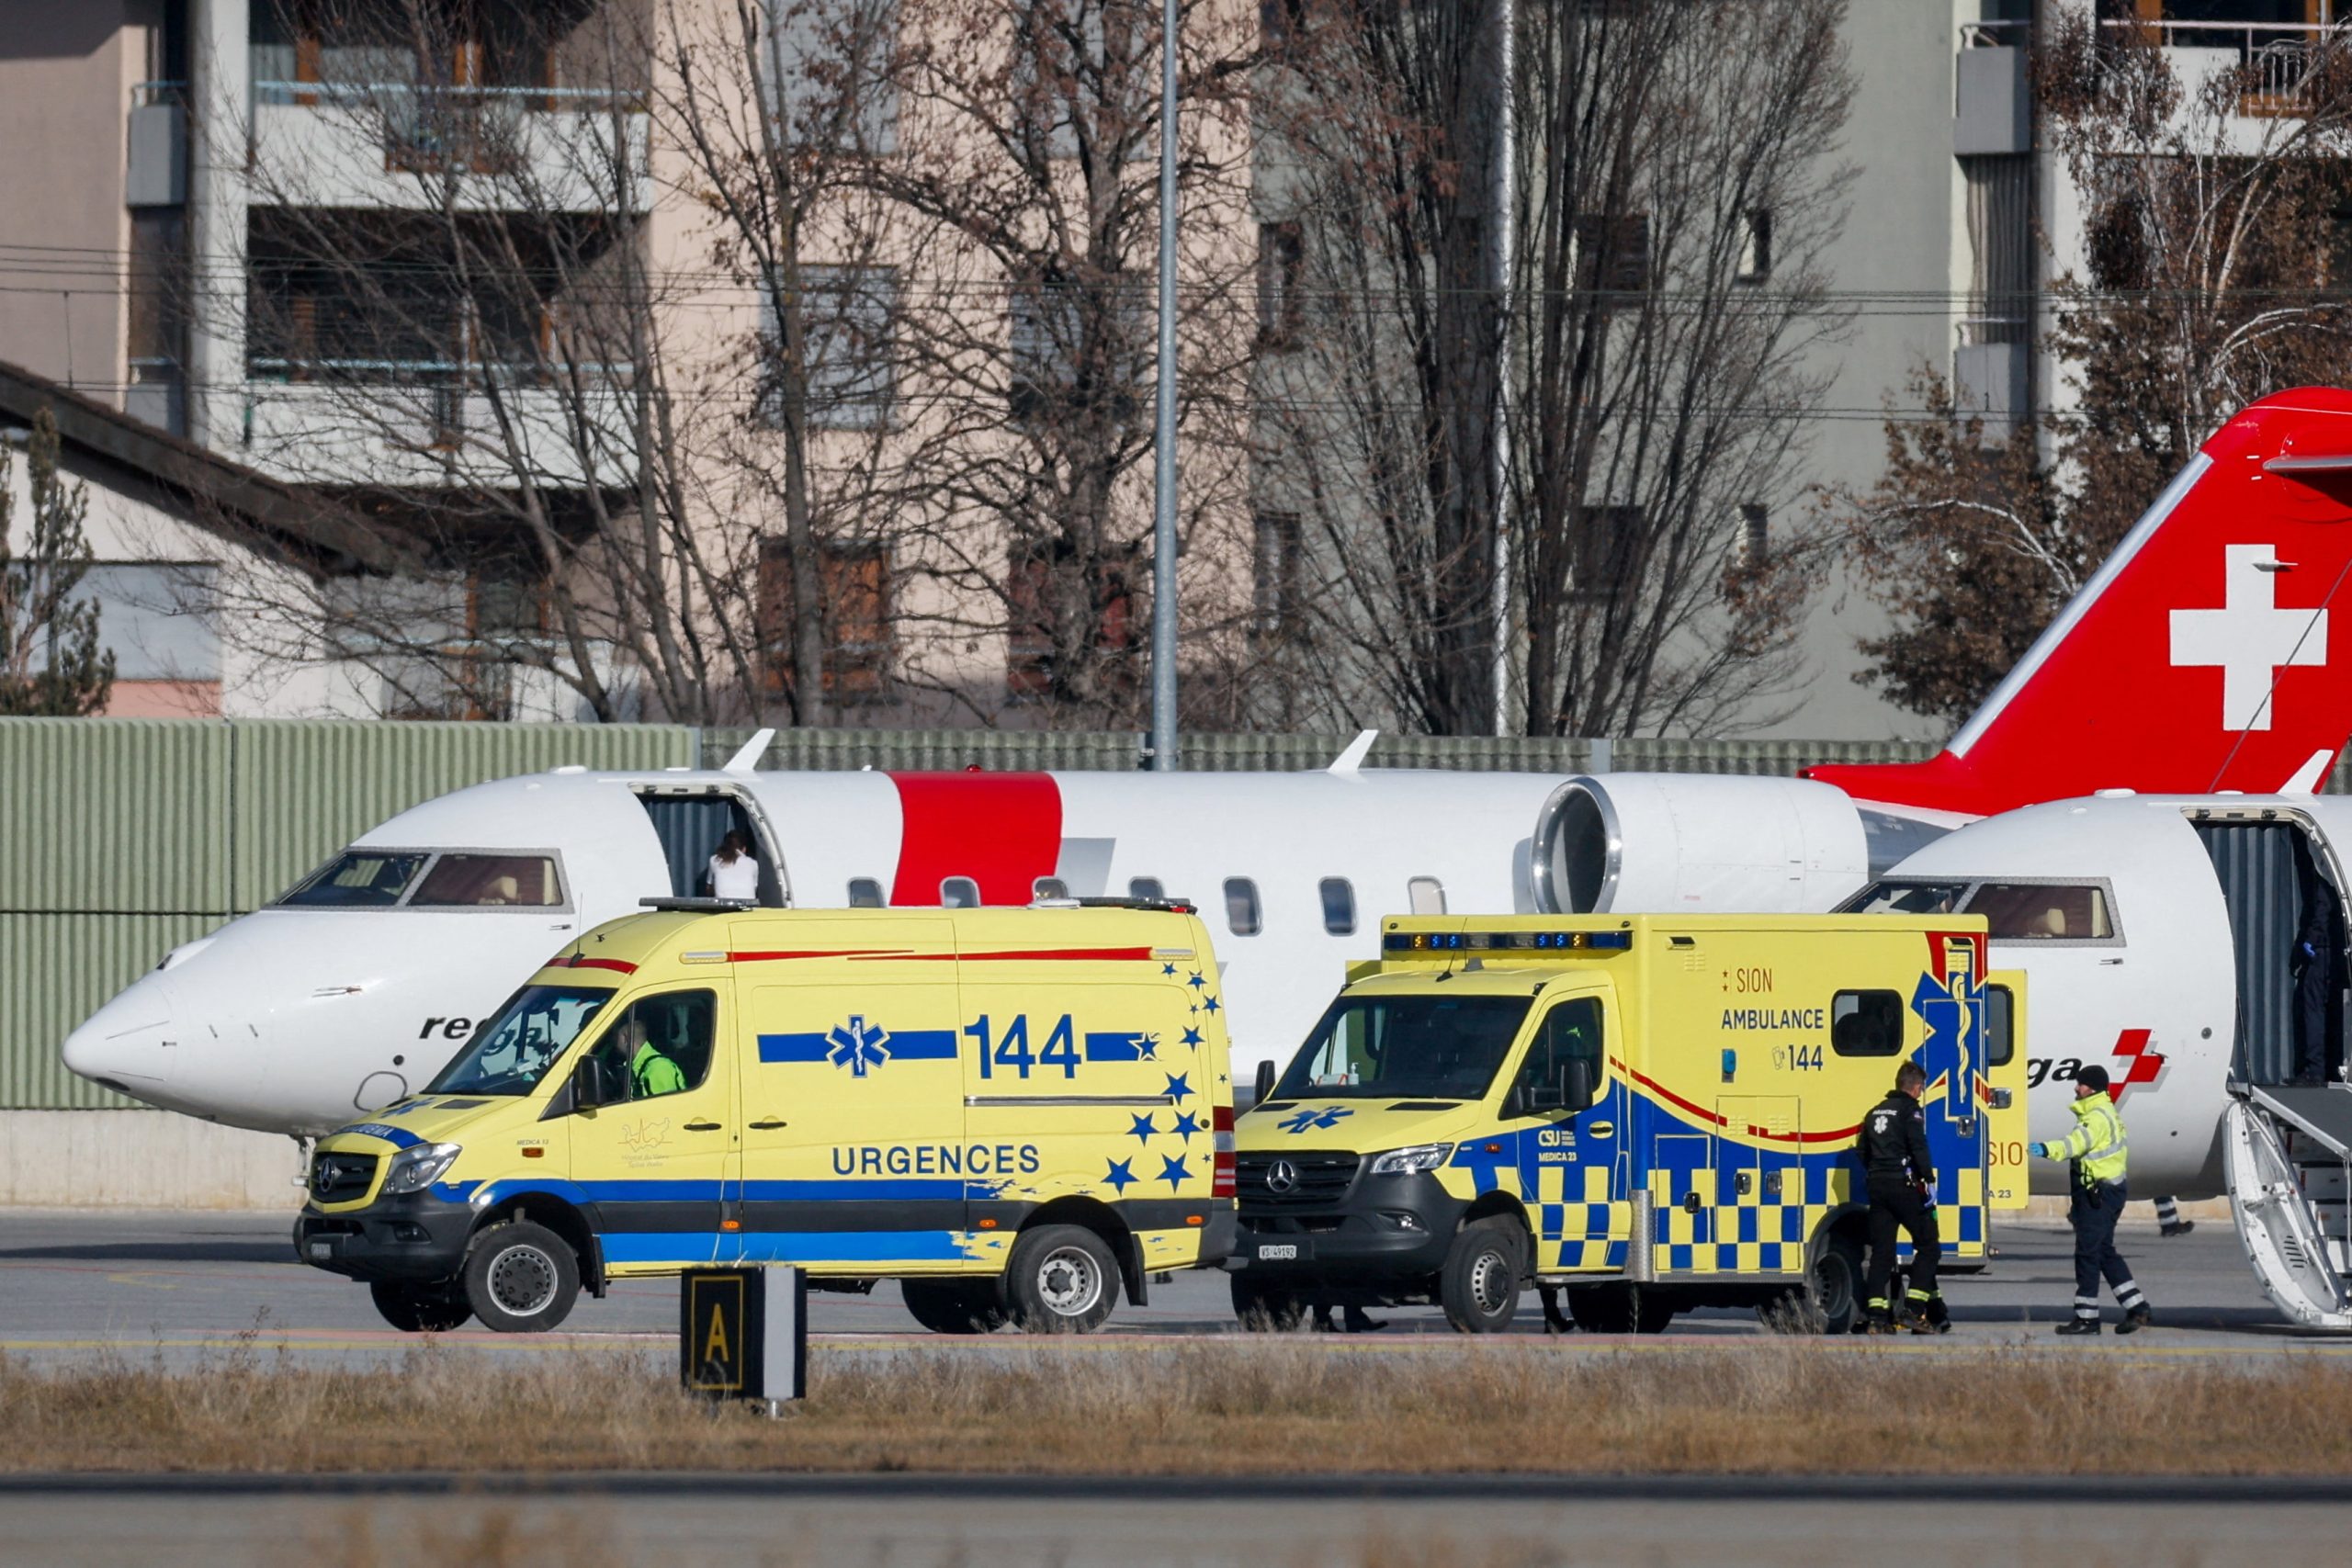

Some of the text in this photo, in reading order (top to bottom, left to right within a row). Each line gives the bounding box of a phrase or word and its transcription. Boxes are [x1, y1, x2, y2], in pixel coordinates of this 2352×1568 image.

[1736, 967, 1772, 993] SION
[1721, 1009, 1824, 1030] AMBULANCE
[964, 1014, 1081, 1078] 144
[1788, 1044, 1823, 1071] 144
[2026, 1058, 2082, 1089] ga
[1538, 1130, 1560, 1146] CSU
[833, 1145, 1039, 1175] URGENCES
[1538, 1151, 1577, 1162] MEDICA 23
[1997, 1190, 2011, 1198] 23
[1272, 1247, 1295, 1258] 49192
[706, 1303, 729, 1362] A
